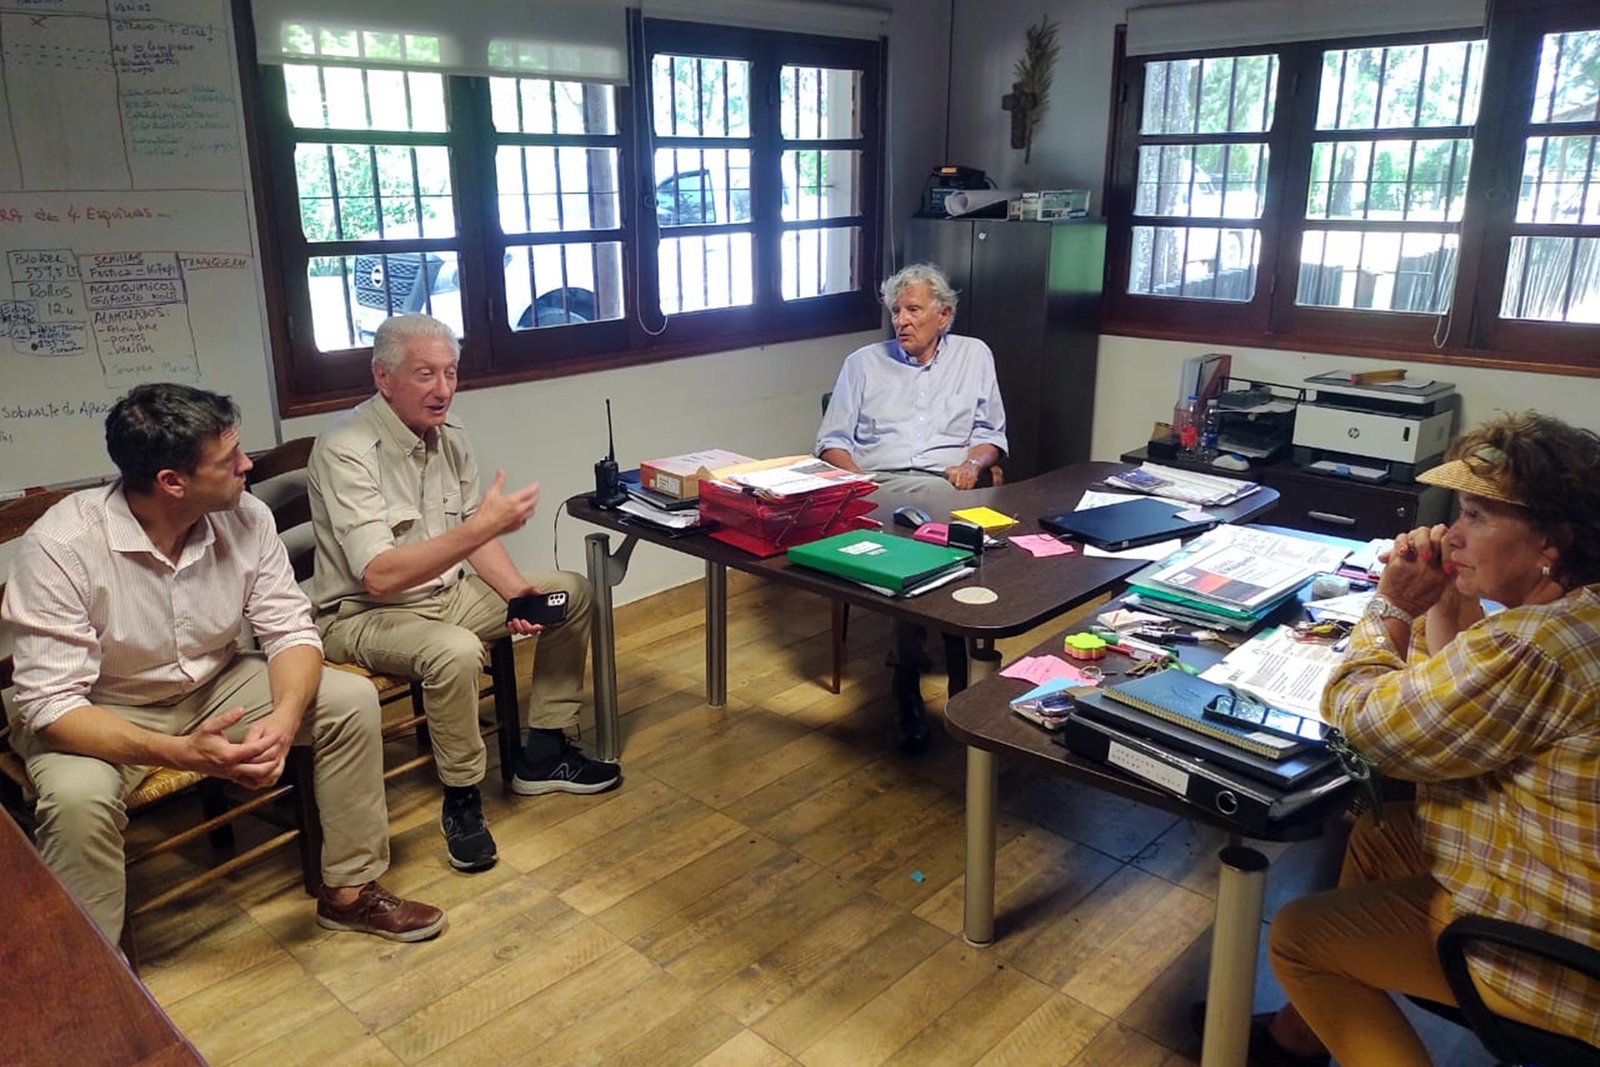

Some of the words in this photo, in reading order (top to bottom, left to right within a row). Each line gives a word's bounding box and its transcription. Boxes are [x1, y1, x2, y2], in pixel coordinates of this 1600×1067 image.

[67, 205, 81, 224] 4
[28, 283, 73, 299] Rollos
[48, 303, 63, 316] 12
